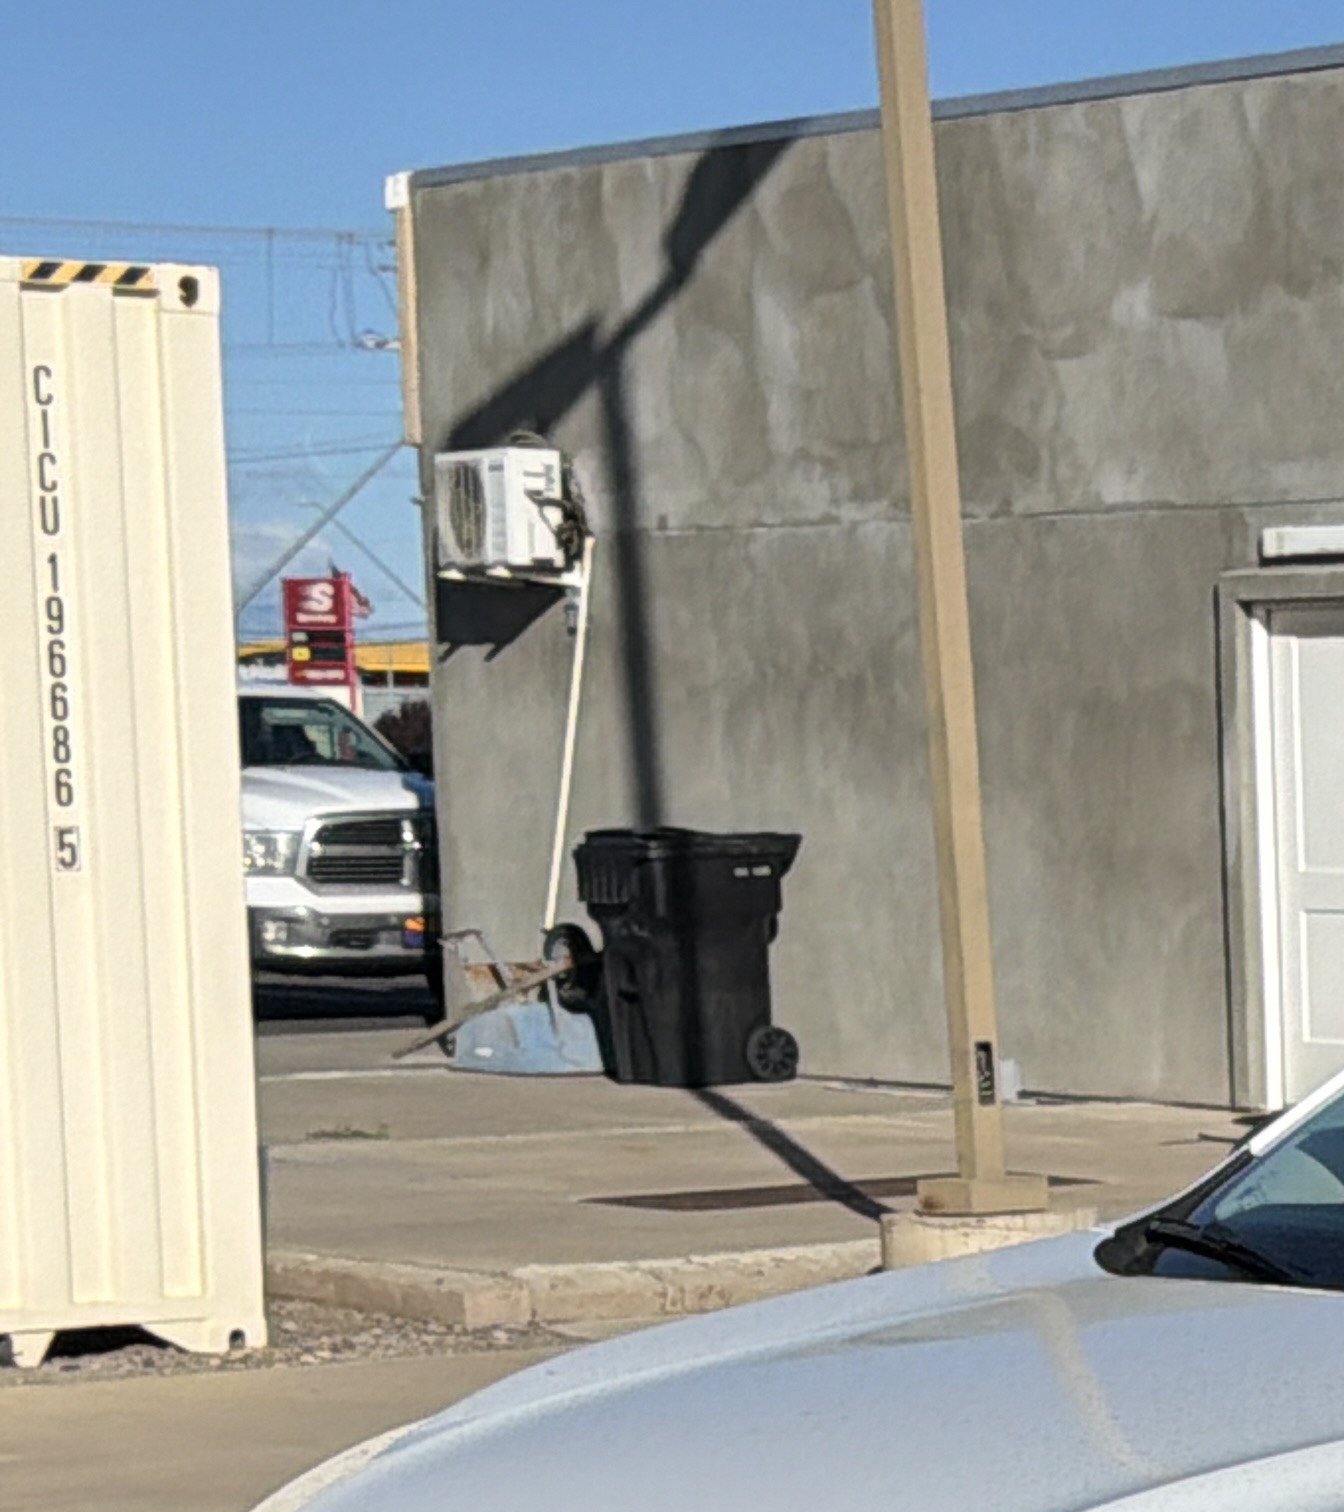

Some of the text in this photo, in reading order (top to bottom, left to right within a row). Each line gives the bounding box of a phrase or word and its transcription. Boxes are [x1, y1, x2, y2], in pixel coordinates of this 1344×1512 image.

[33, 365, 78, 868] CICU 196686 5
